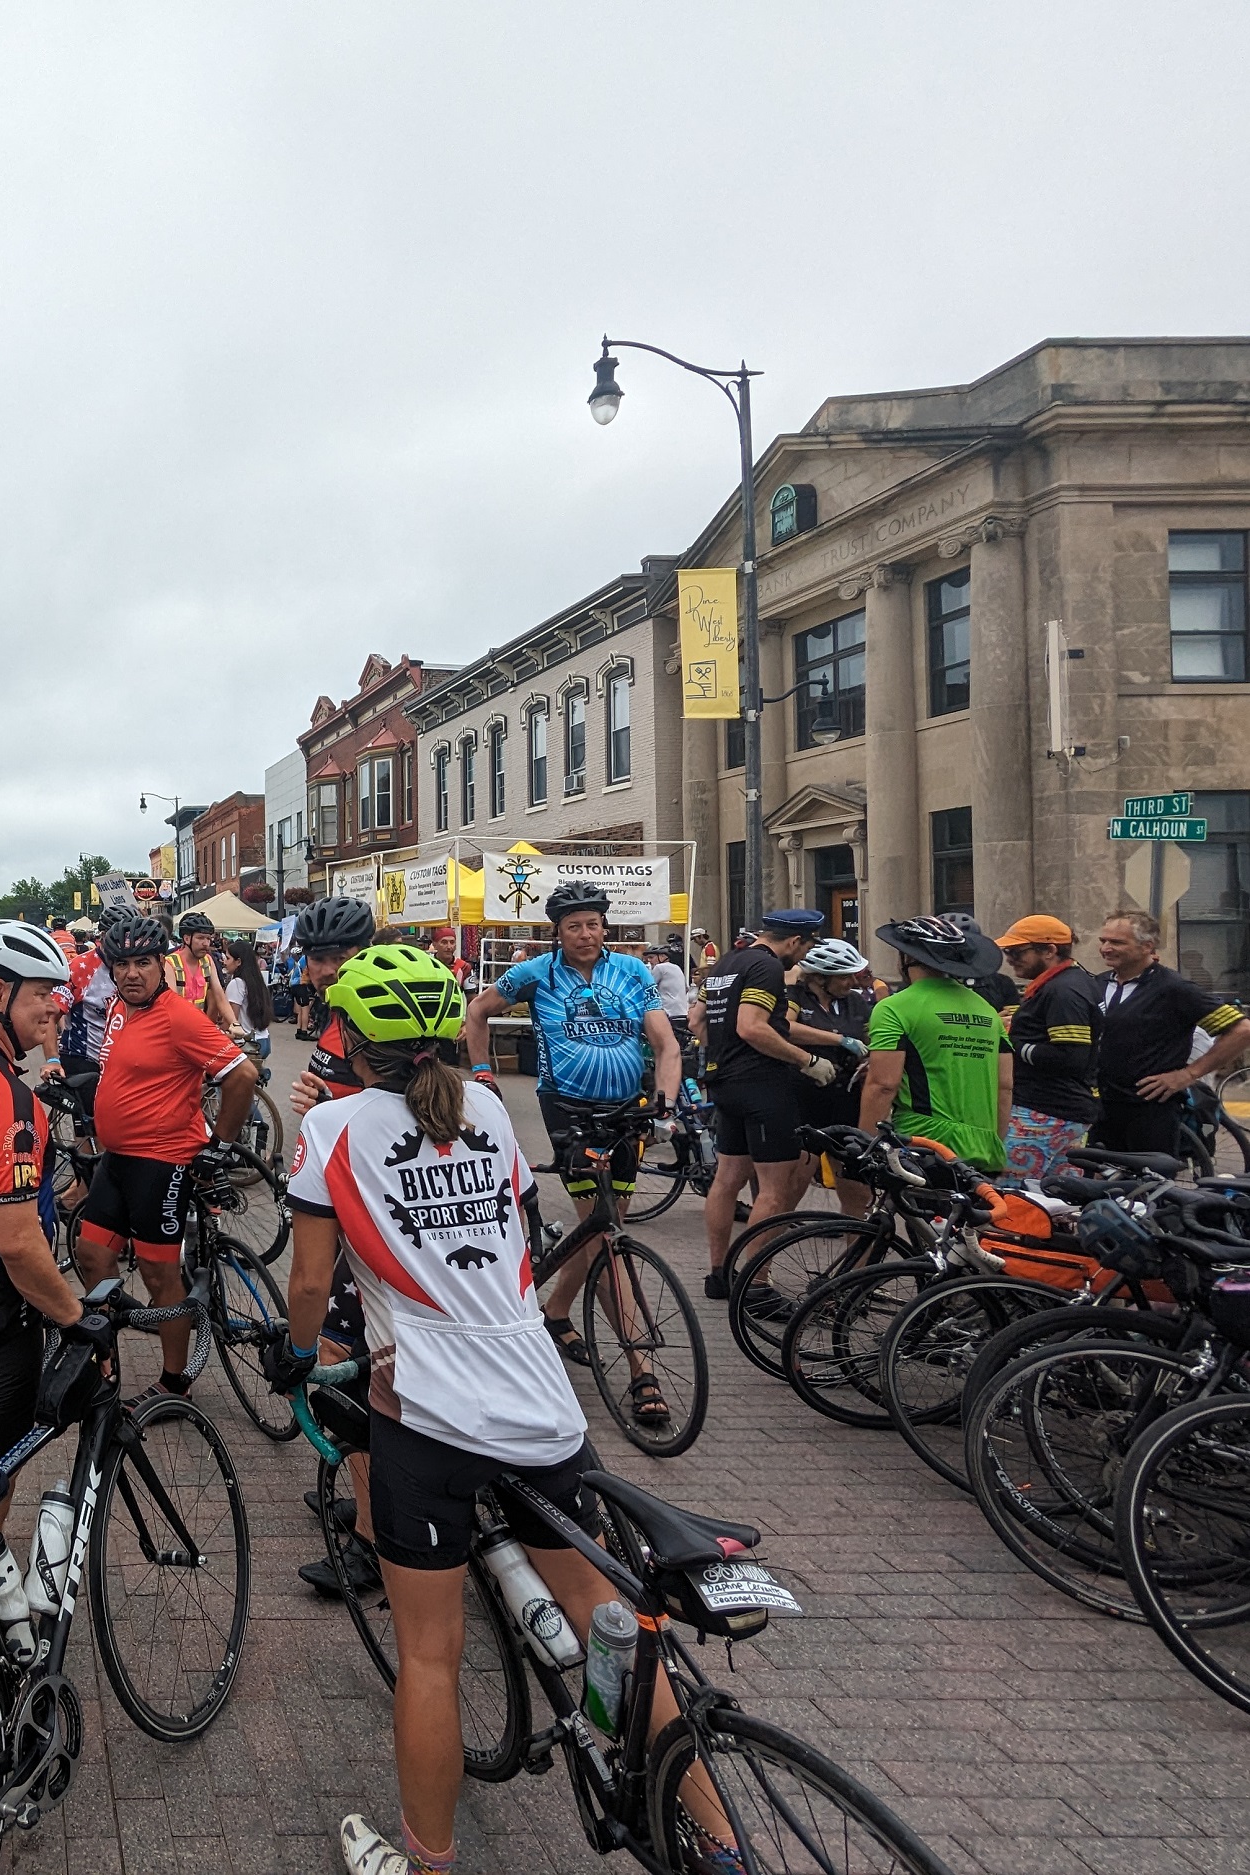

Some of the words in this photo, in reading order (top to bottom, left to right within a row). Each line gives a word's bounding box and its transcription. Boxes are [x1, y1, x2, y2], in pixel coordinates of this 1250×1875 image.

[820, 532, 869, 570] TRUST
[875, 484, 971, 542] COMPANY
[692, 607, 723, 633] West
[703, 625, 736, 652] Liberty
[1127, 799, 1164, 816] THIRD
[1173, 796, 1188, 813] ST
[1113, 821, 1121, 836] N
[1130, 821, 1187, 837] CALHOUN
[1196, 826, 1205, 835] ST
[410, 867, 432, 881] CUSTOM
[432, 864, 447, 877] TAGS
[557, 864, 615, 876] CUSTOM
[618, 865, 653, 876] TAGS
[96, 881, 110, 893] West
[110, 879, 128, 891] Liberty
[110, 895, 126, 905] Lions
[951, 1013, 970, 1022] TEAM
[972, 1015, 984, 1024] FLY
[398, 1157, 495, 1201] BICYCLE
[162, 1164, 186, 1218] Alliance
[410, 1205, 459, 1228] SPORT
[463, 1200, 498, 1222] SHOP
[467, 1226, 497, 1237] TEXAS
[58, 1460, 102, 1622] TREK
[707, 1582, 743, 1593] Daphne
[714, 1595, 752, 1605] Seasoned
